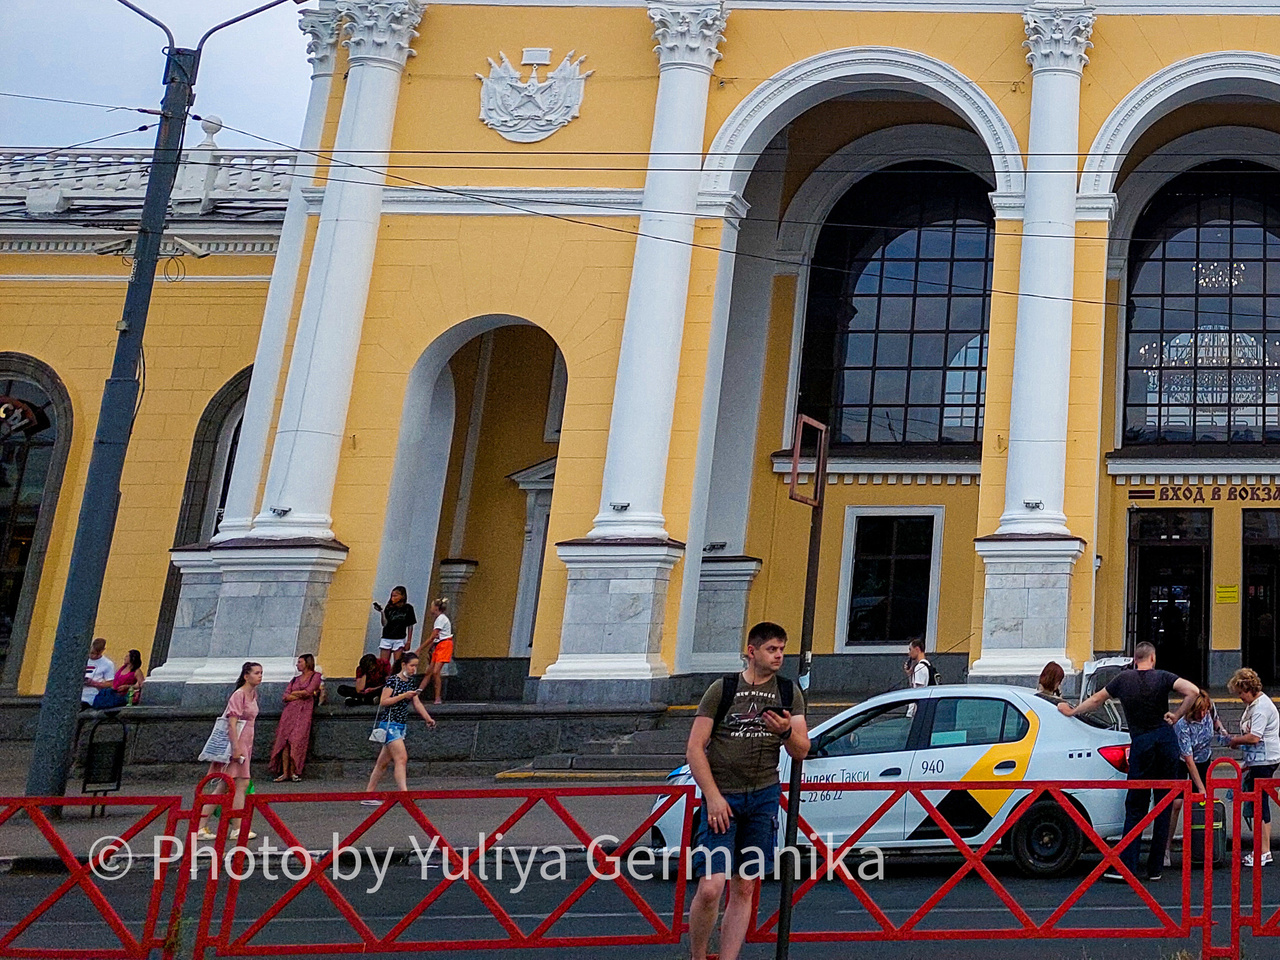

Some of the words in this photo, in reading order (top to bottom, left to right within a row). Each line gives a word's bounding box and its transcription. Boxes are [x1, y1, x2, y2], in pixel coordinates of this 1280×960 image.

[1158, 486, 1206, 504] ВХОД
[1210, 486, 1222, 501] В
[921, 759, 945, 775] 940
[840, 768, 870, 784] Такси
[809, 792, 818, 803] 22
[820, 790, 831, 802] 66
